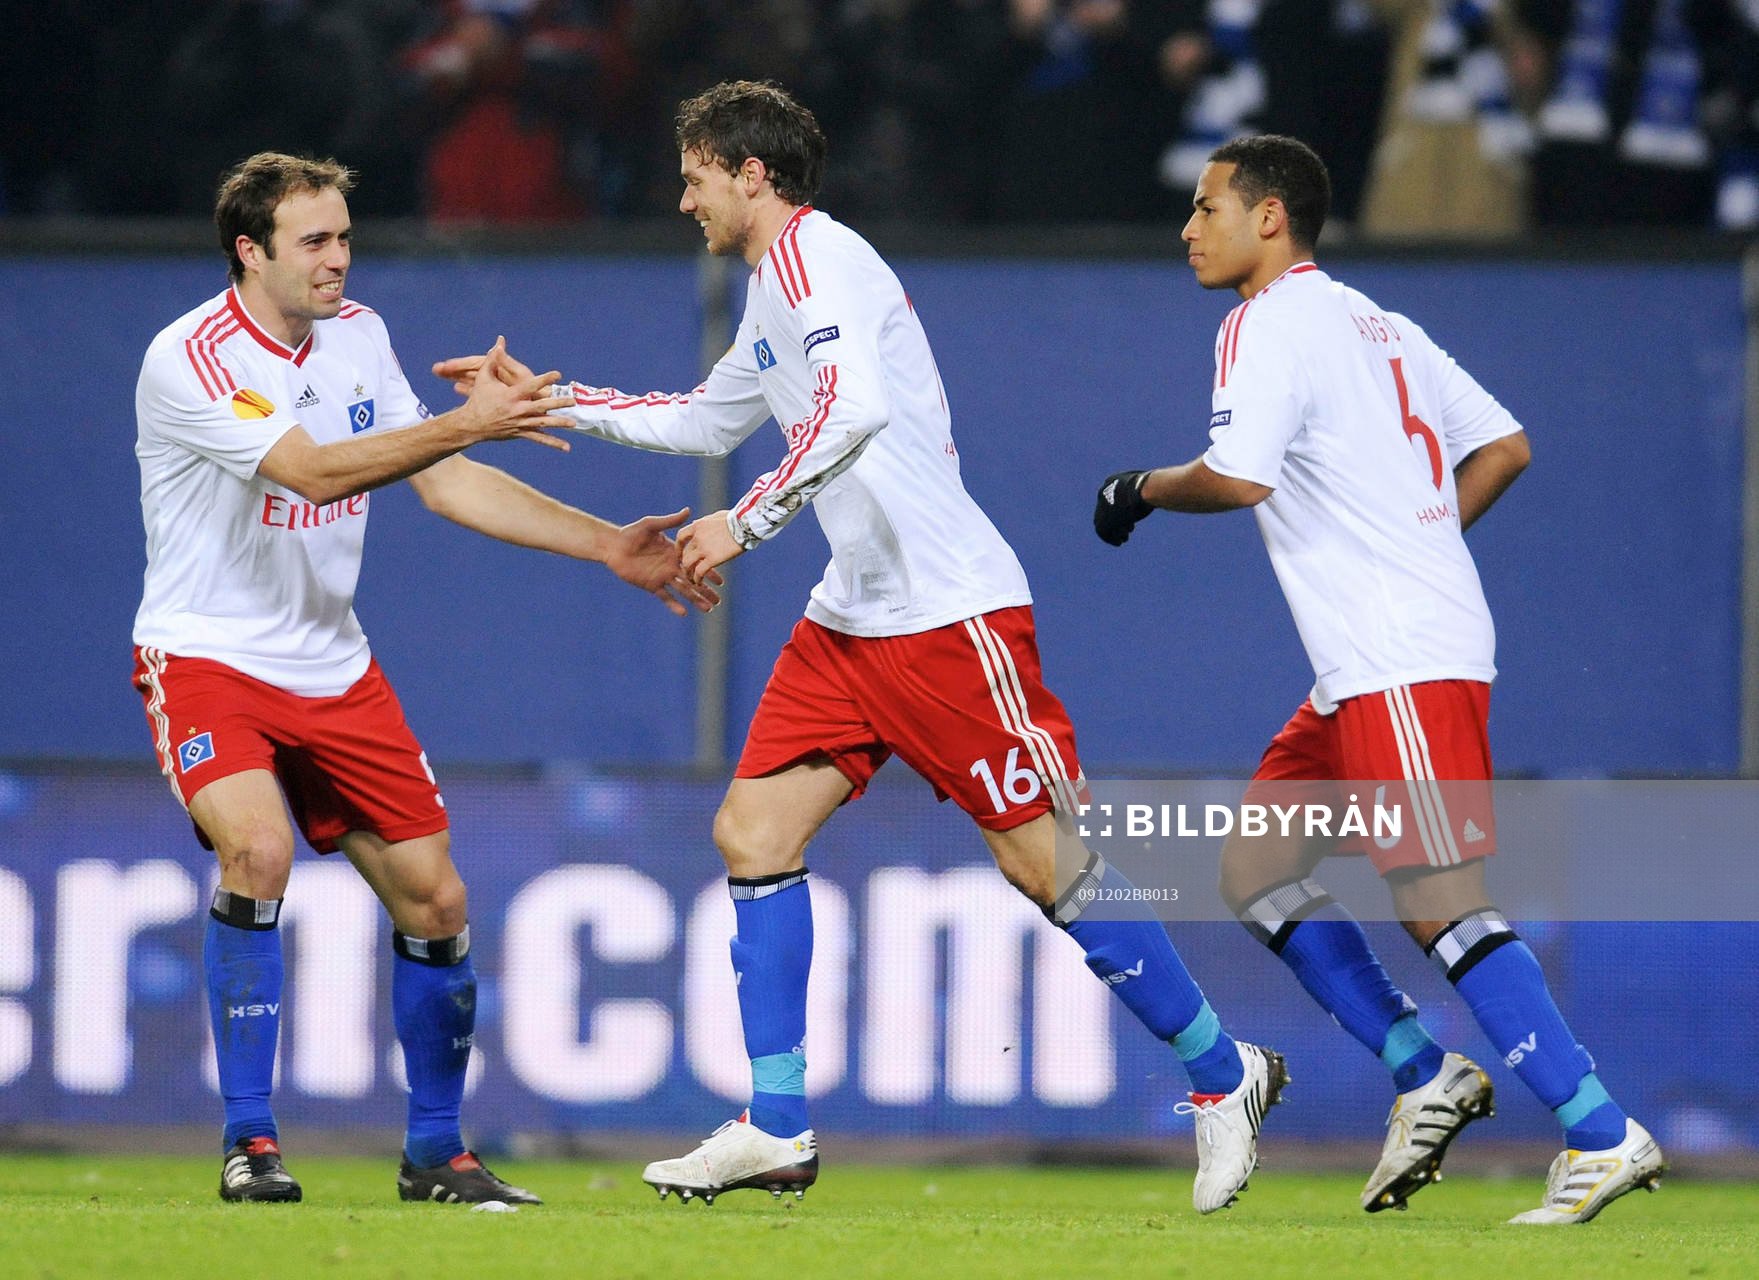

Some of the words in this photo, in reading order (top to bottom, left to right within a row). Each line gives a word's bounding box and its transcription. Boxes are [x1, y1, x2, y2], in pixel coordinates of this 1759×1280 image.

[262, 492, 369, 531] Emirate
[1416, 502, 1457, 526] HAM
[970, 747, 1041, 813] 16
[229, 1002, 279, 1018] HSV
